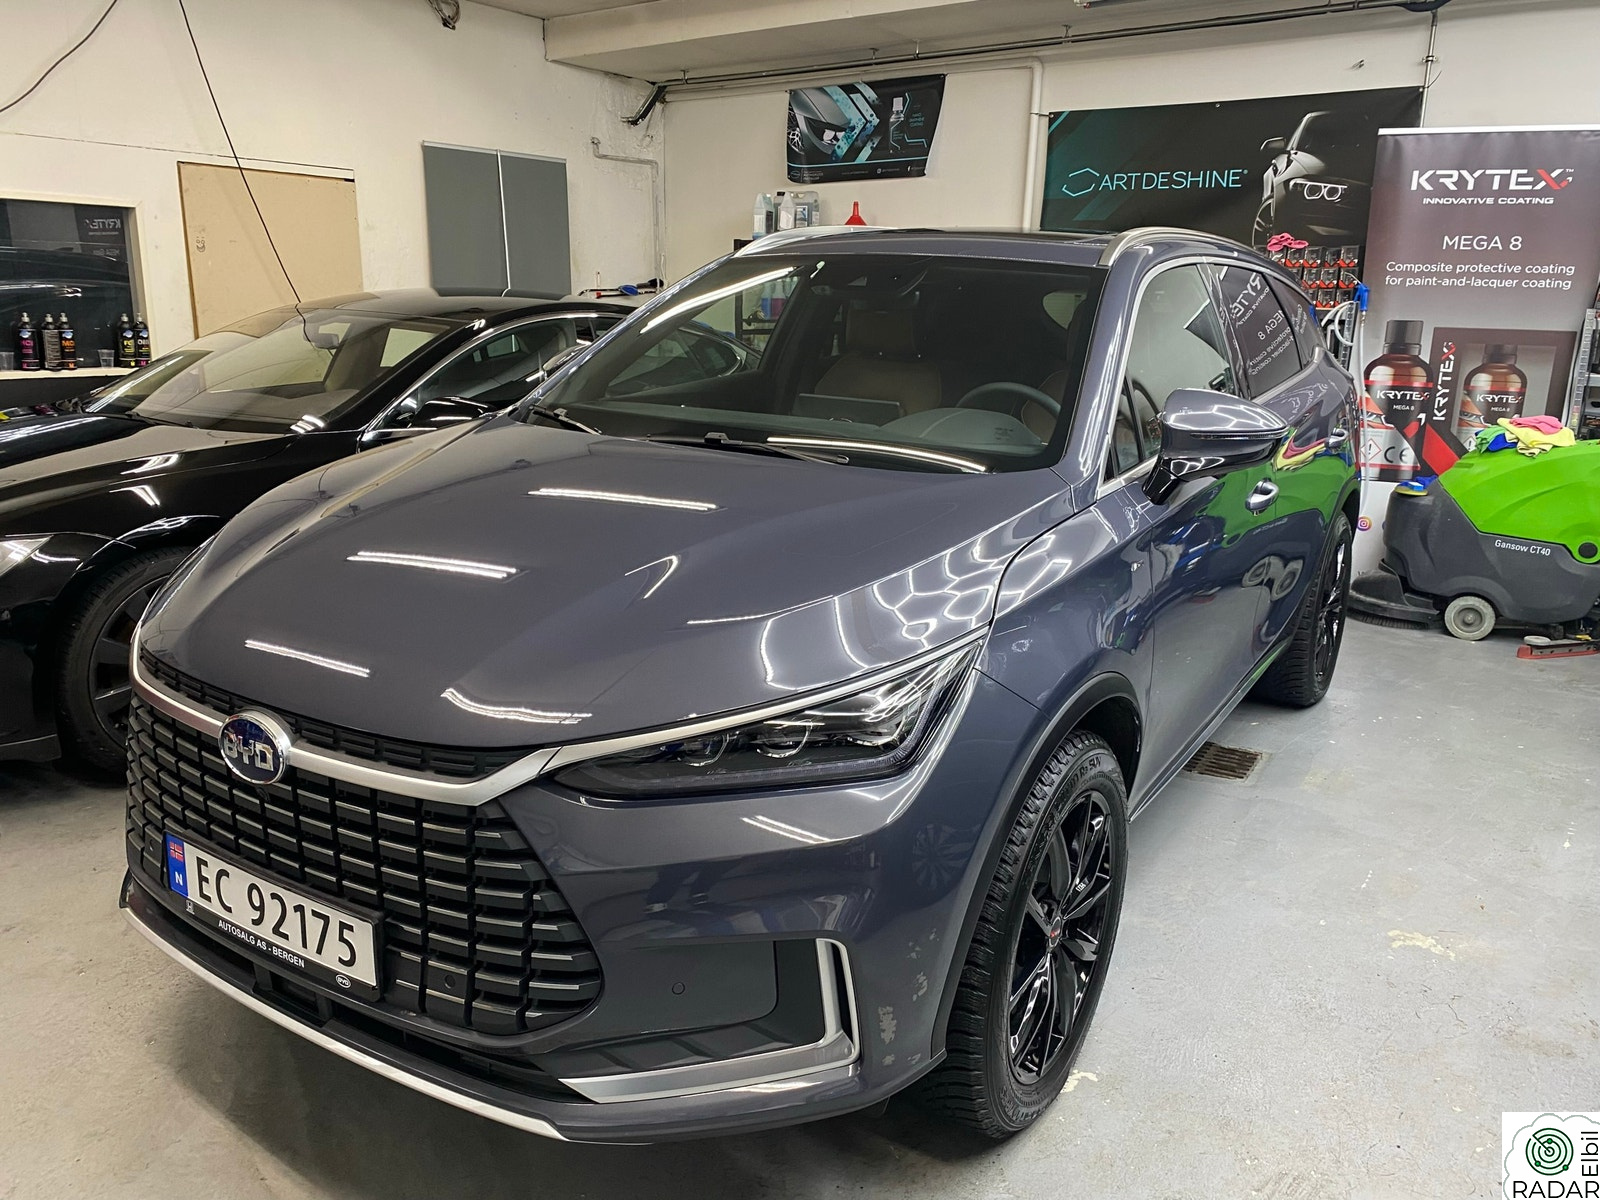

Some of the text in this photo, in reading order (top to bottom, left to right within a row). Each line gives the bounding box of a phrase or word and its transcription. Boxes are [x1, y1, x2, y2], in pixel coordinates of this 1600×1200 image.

[1422, 197, 1554, 205] INNOVATIVE COATING
[1442, 235, 1522, 250] MEGA 8
[1386, 261, 1575, 276] Composite protective coating
[1385, 276, 1572, 290] for paint-and-lacquer coating
[1433, 341, 1456, 421] KRYTEX
[1376, 390, 1430, 400] KRYTEX
[1495, 539, 1551, 556] Gansow CT40
[223, 729, 274, 772] BYD
[174, 871, 183, 886] N
[196, 856, 357, 967] EC 92175
[218, 919, 255, 945] AUTOSALG
[256, 939, 267, 951] AS
[272, 946, 305, 968] BERGEN
